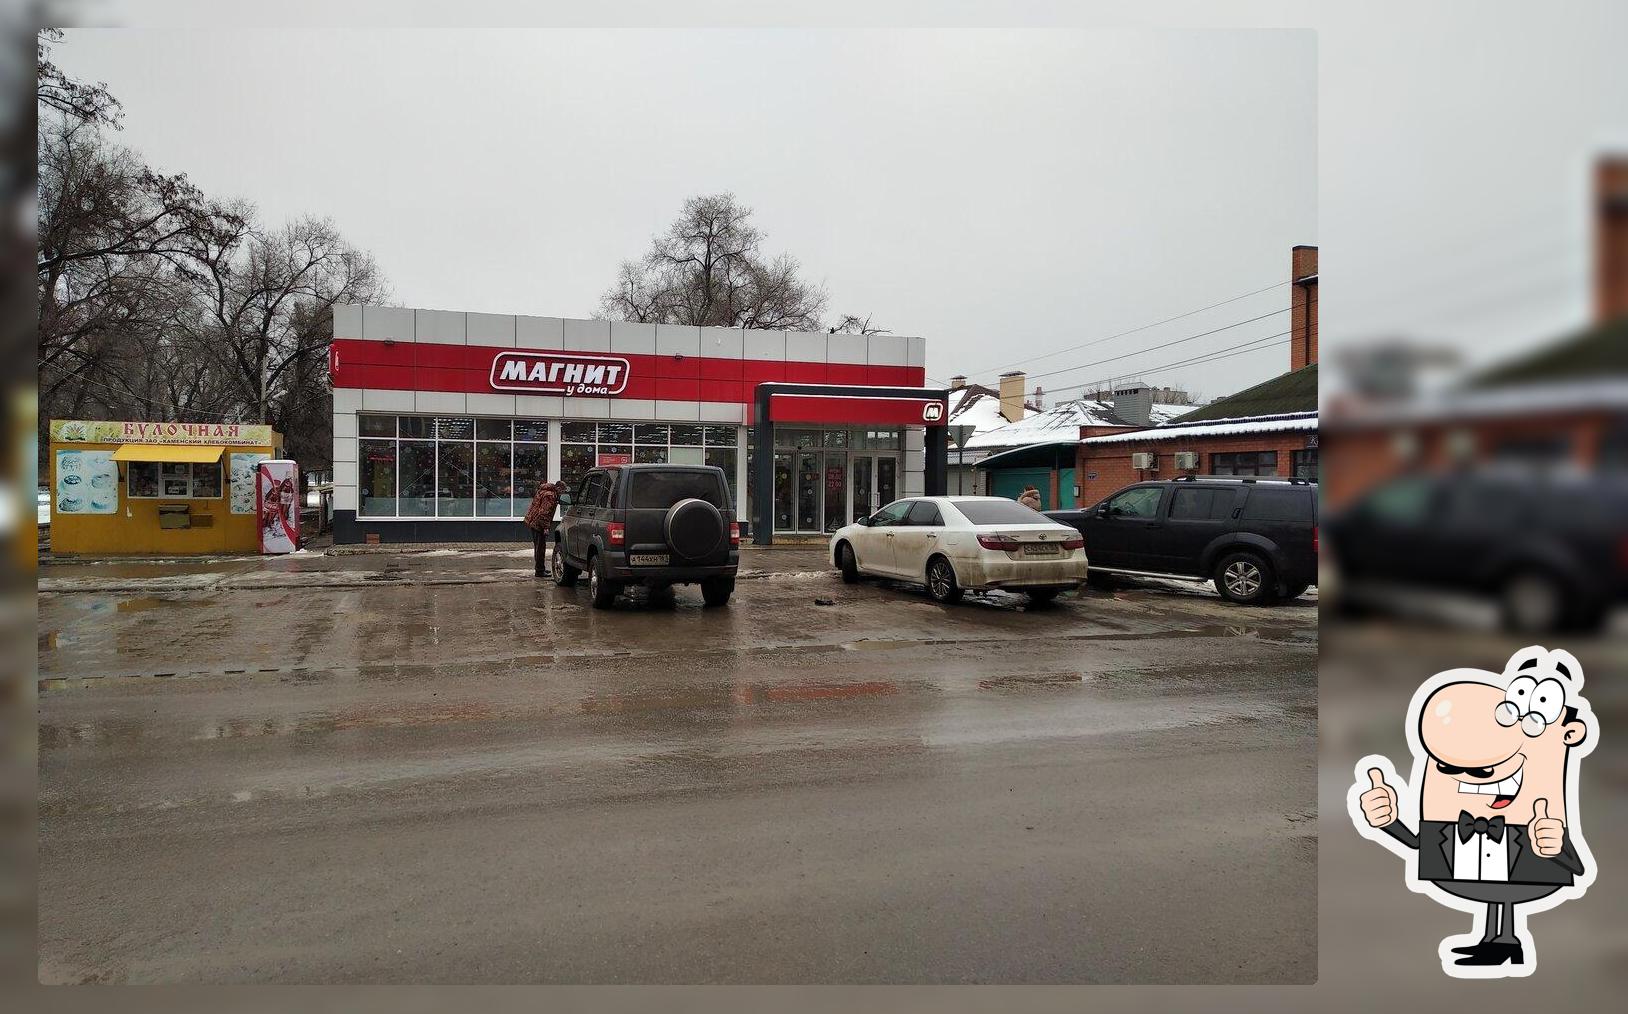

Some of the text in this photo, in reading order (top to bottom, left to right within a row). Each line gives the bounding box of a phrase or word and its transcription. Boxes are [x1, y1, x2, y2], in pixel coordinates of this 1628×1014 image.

[499, 360, 622, 385] МАГНИТ
[566, 383, 608, 396] у дома
[123, 422, 240, 438] БУЛОЧНАЯ
